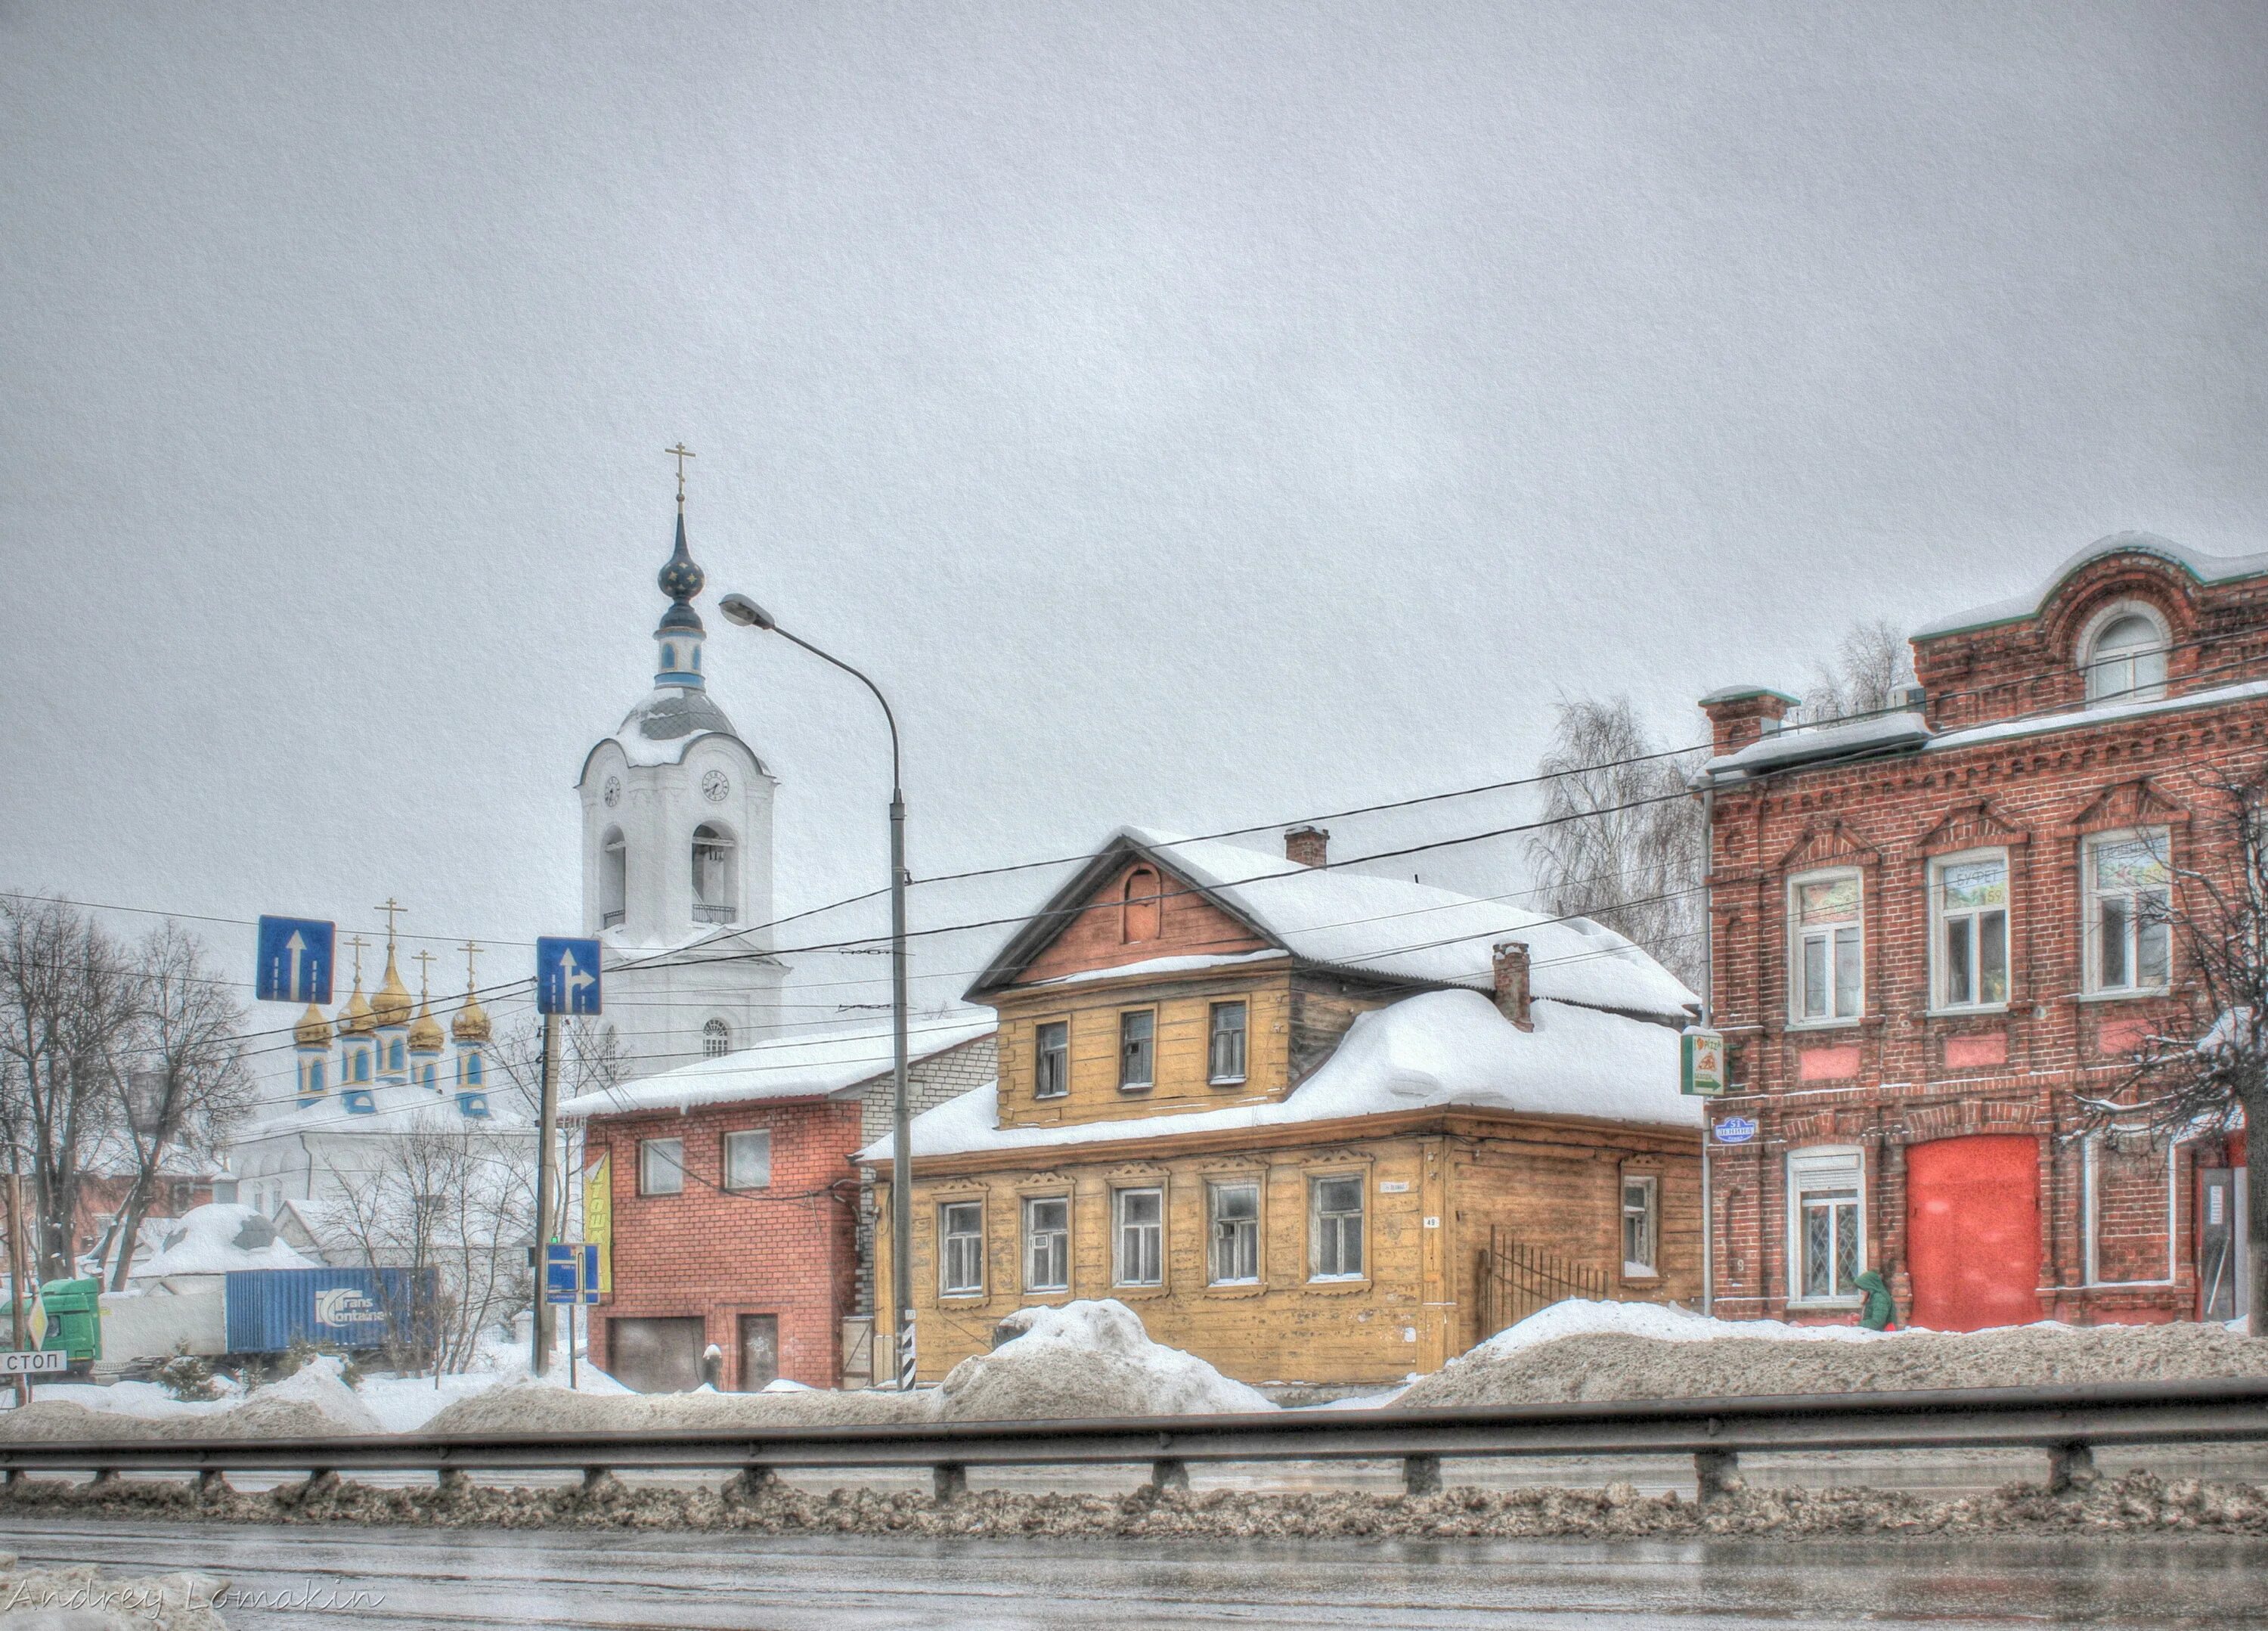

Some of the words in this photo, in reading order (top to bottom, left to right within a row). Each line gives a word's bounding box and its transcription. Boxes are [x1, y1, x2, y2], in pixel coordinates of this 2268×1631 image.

[1957, 869, 1998, 885] БУФЕТ
[1987, 889, 2002, 902] 59
[7, 1353, 57, 1370] СТОП
